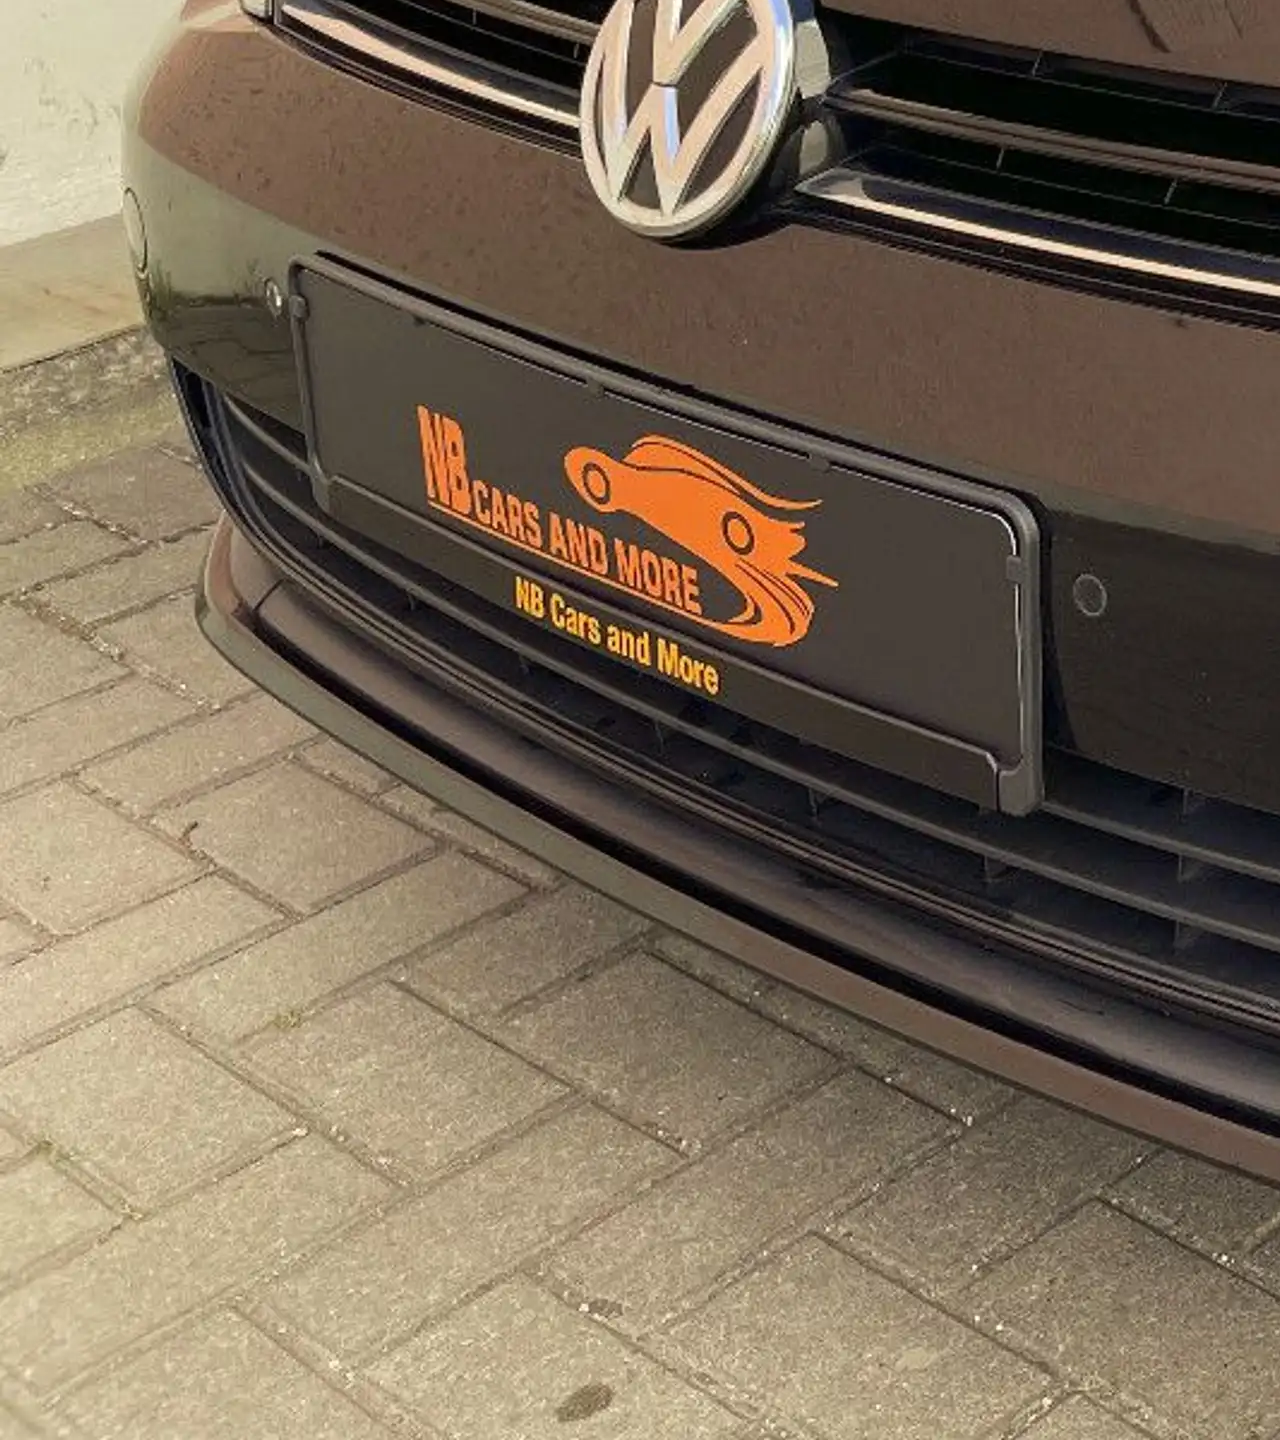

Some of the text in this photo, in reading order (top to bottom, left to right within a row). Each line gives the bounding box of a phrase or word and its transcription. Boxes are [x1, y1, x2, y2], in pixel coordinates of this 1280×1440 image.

[417, 405, 702, 615] NB CARS AND MORE
[515, 575, 719, 695] NB Cars and More
